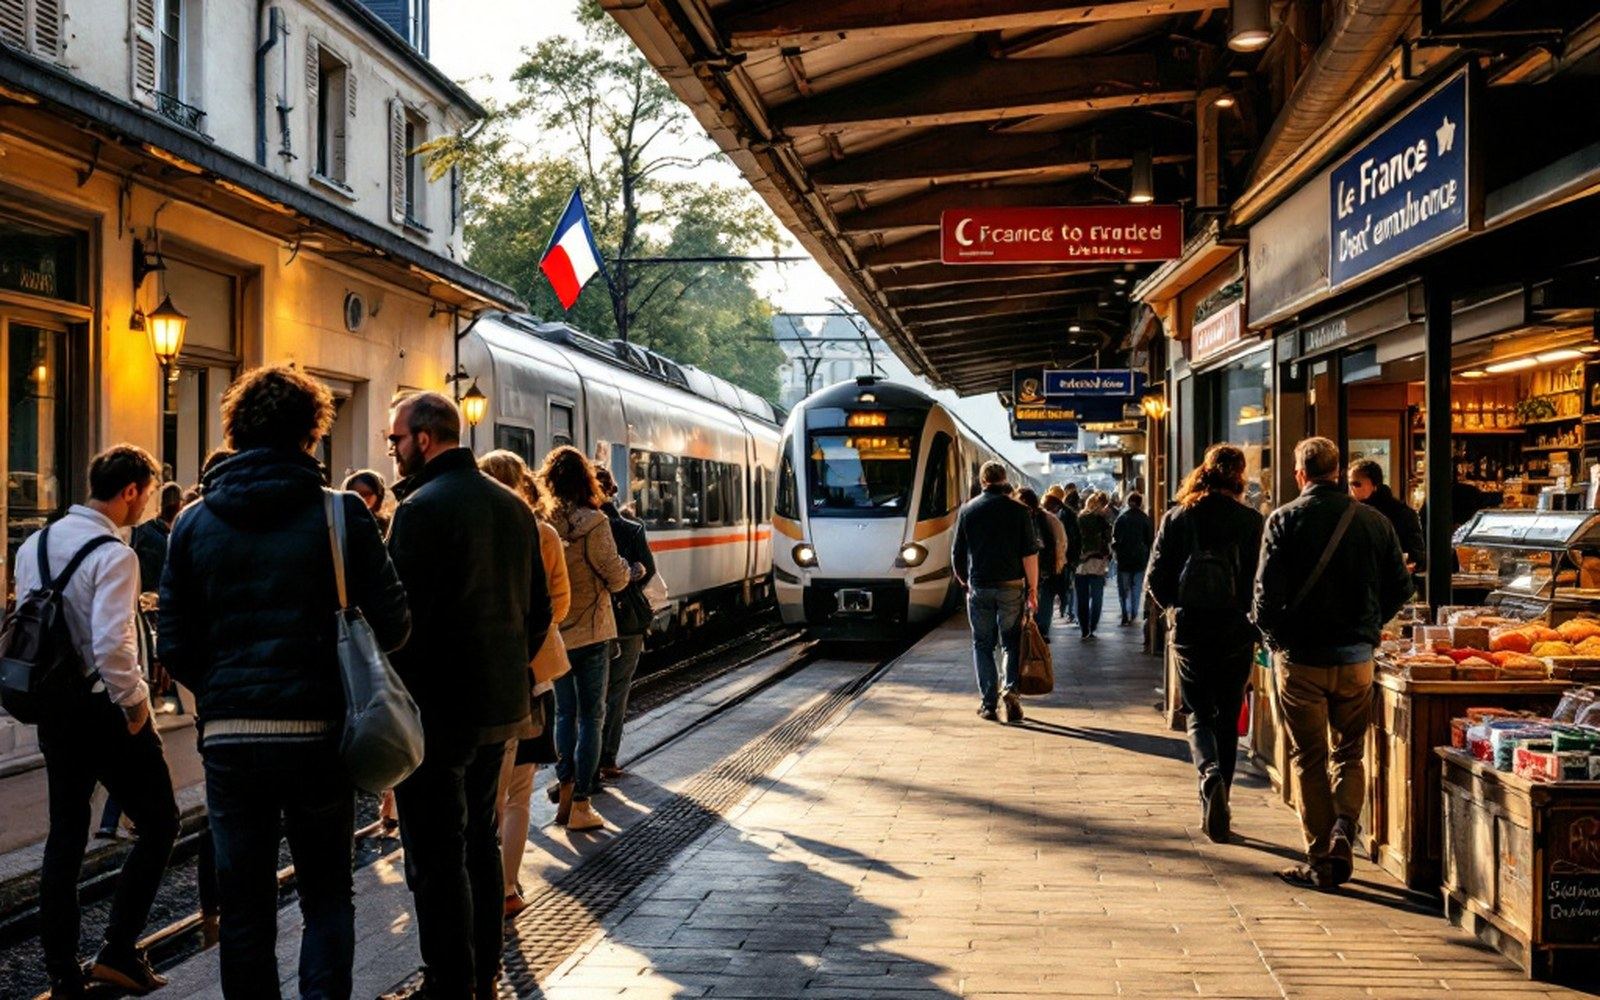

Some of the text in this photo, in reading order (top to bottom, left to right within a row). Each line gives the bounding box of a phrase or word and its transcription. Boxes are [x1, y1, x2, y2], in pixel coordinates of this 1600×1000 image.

[1337, 138, 1428, 220] Le France
[1061, 224, 1083, 241] to
